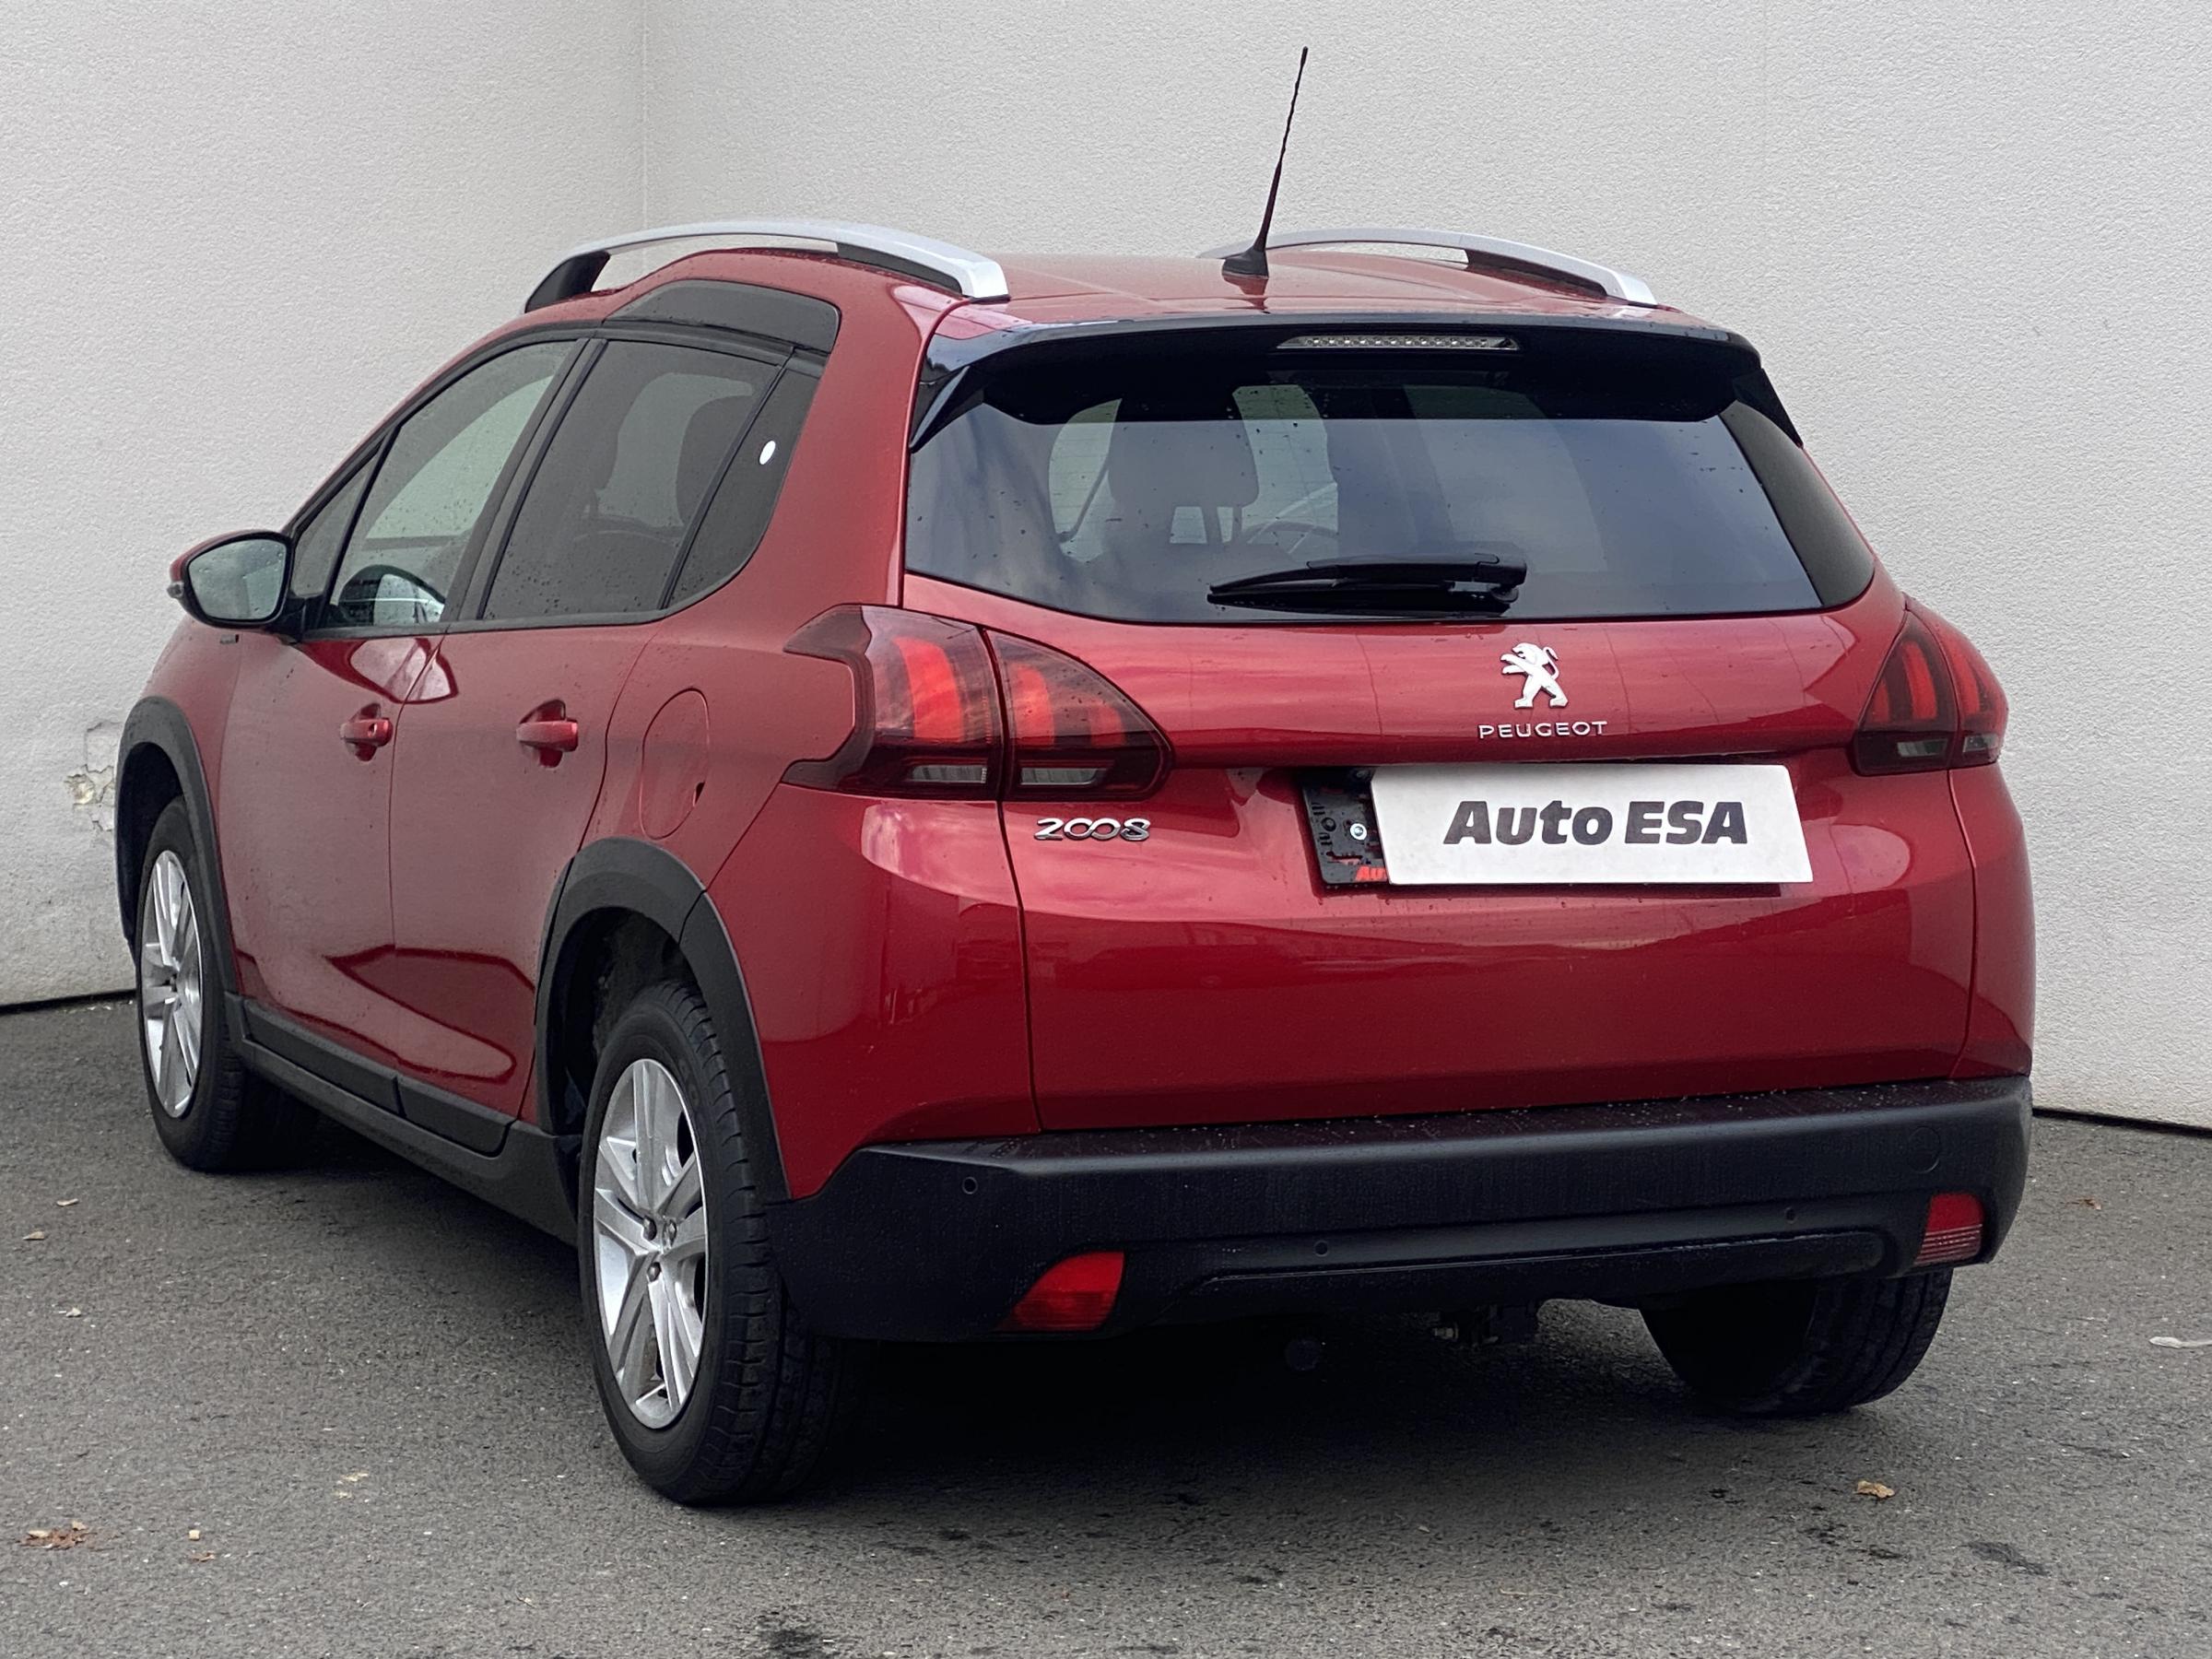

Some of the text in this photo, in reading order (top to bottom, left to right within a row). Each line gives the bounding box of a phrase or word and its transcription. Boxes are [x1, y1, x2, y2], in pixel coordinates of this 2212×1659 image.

[1478, 721, 1608, 739] PEUGEOT
[1033, 817, 1151, 841] 2008
[1443, 800, 1748, 845] Auto ESA
